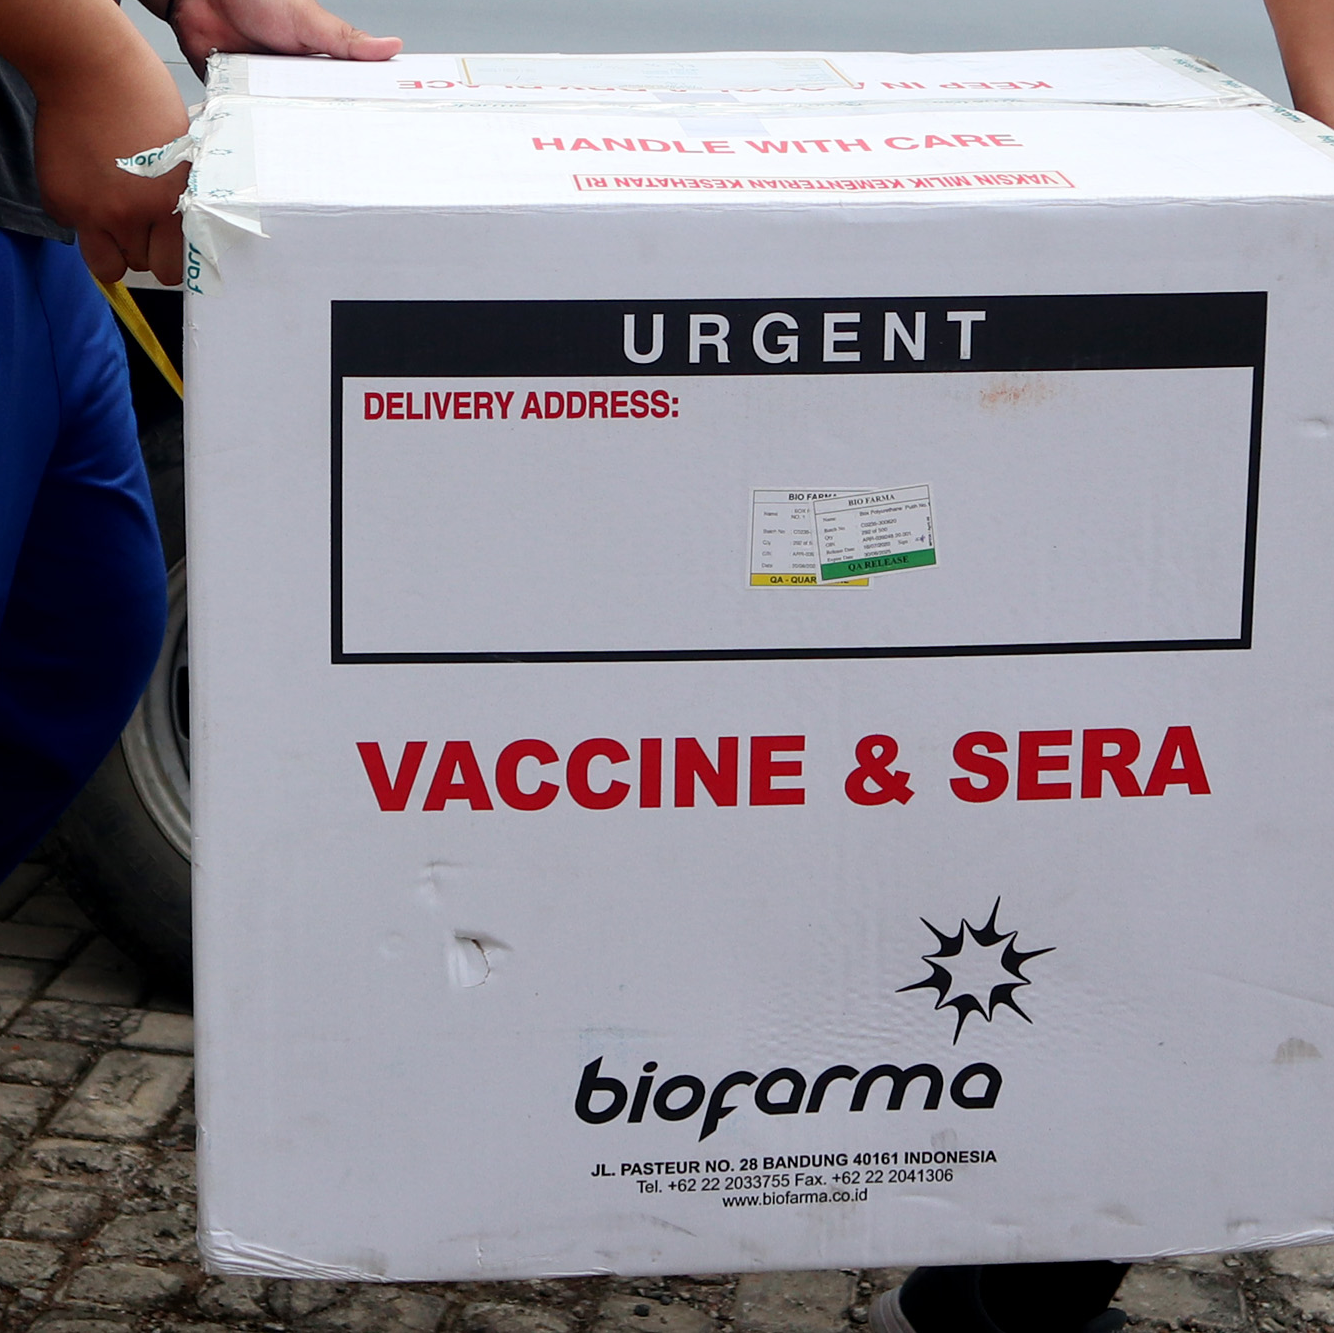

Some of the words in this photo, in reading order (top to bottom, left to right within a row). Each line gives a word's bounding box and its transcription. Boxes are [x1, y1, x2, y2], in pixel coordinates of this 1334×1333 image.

[880, 81, 927, 90] IN
[938, 81, 1054, 91] KEEP
[532, 137, 736, 154] HANDLE
[745, 137, 873, 154] WITH
[884, 134, 1023, 151] CARE
[585, 177, 609, 188] RI
[614, 177, 744, 189] KESEHATAN
[747, 177, 906, 191] KEMENTERIAN
[915, 175, 972, 189] MILIK
[973, 173, 1056, 186] VAKSIN
[623, 310, 986, 364] URGENT
[364, 391, 515, 421] DELIVERY
[521, 390, 679, 421] ADDRESS:
[788, 493, 804, 501] BIO
[848, 498, 864, 507] BIO
[865, 494, 895, 505] FARMA
[848, 561, 864, 572] QA
[865, 556, 909, 569] RELEASE
[770, 576, 784, 585] QA
[357, 735, 806, 812] VACCINE
[845, 734, 915, 806] &
[950, 725, 1211, 803] SERA
[575, 1056, 1003, 1142] biofarma
[591, 1164, 616, 1177] JL.
[620, 1161, 700, 1176] PASTEUR
[705, 1159, 735, 1173] NO.
[739, 1158, 759, 1171] 28
[763, 1153, 848, 1170] BANDUNG
[852, 1152, 899, 1166] 40161
[904, 1150, 998, 1165] INDONESIA
[636, 1180, 663, 1193] Tel.
[668, 1178, 697, 1192] +62
[701, 1177, 720, 1191] 22
[724, 1174, 790, 1190] 2033755
[794, 1172, 827, 1187] Fax.
[832, 1171, 860, 1185] +62
[865, 1170, 884, 1184] 22
[888, 1168, 954, 1183] 2041306
[722, 1188, 868, 1208] www.biofarma.co.id
